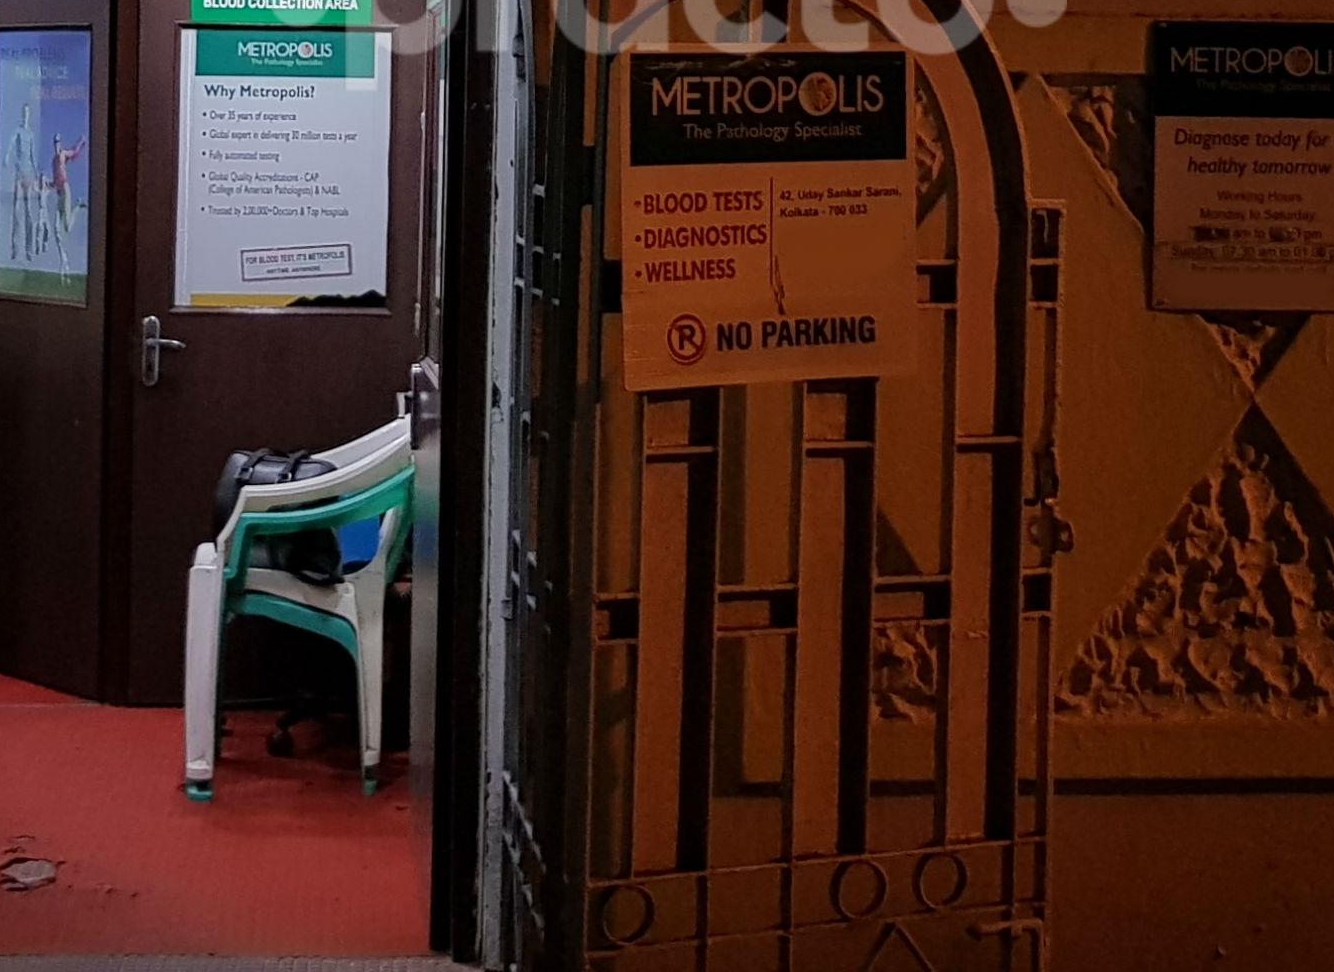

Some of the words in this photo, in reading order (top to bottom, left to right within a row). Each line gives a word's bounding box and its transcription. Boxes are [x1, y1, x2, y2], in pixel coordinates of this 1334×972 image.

[237, 41, 333, 59] METROPOLIS
[204, 83, 236, 101] Why
[240, 84, 315, 102] Metropolis?
[652, 71, 885, 117] METROPOLIS
[683, 122, 712, 140] The
[717, 122, 788, 143] Pathology
[794, 120, 864, 139] Specialist
[1174, 127, 1249, 150] Diagnose
[1255, 130, 1302, 152] today
[1305, 130, 1331, 152] for
[1187, 155, 1247, 178] healthy
[1252, 159, 1332, 176] tomorrow
[643, 192, 707, 215] BLOOD
[713, 190, 764, 212] TESTS
[798, 188, 824, 203] Uday
[827, 187, 863, 199] Sankar
[866, 185, 902, 198] Sarani,
[643, 223, 767, 249] DIAGNOSTICS
[644, 258, 736, 284] WELLNESS
[717, 321, 753, 352] NO
[761, 315, 877, 349] PARKING
